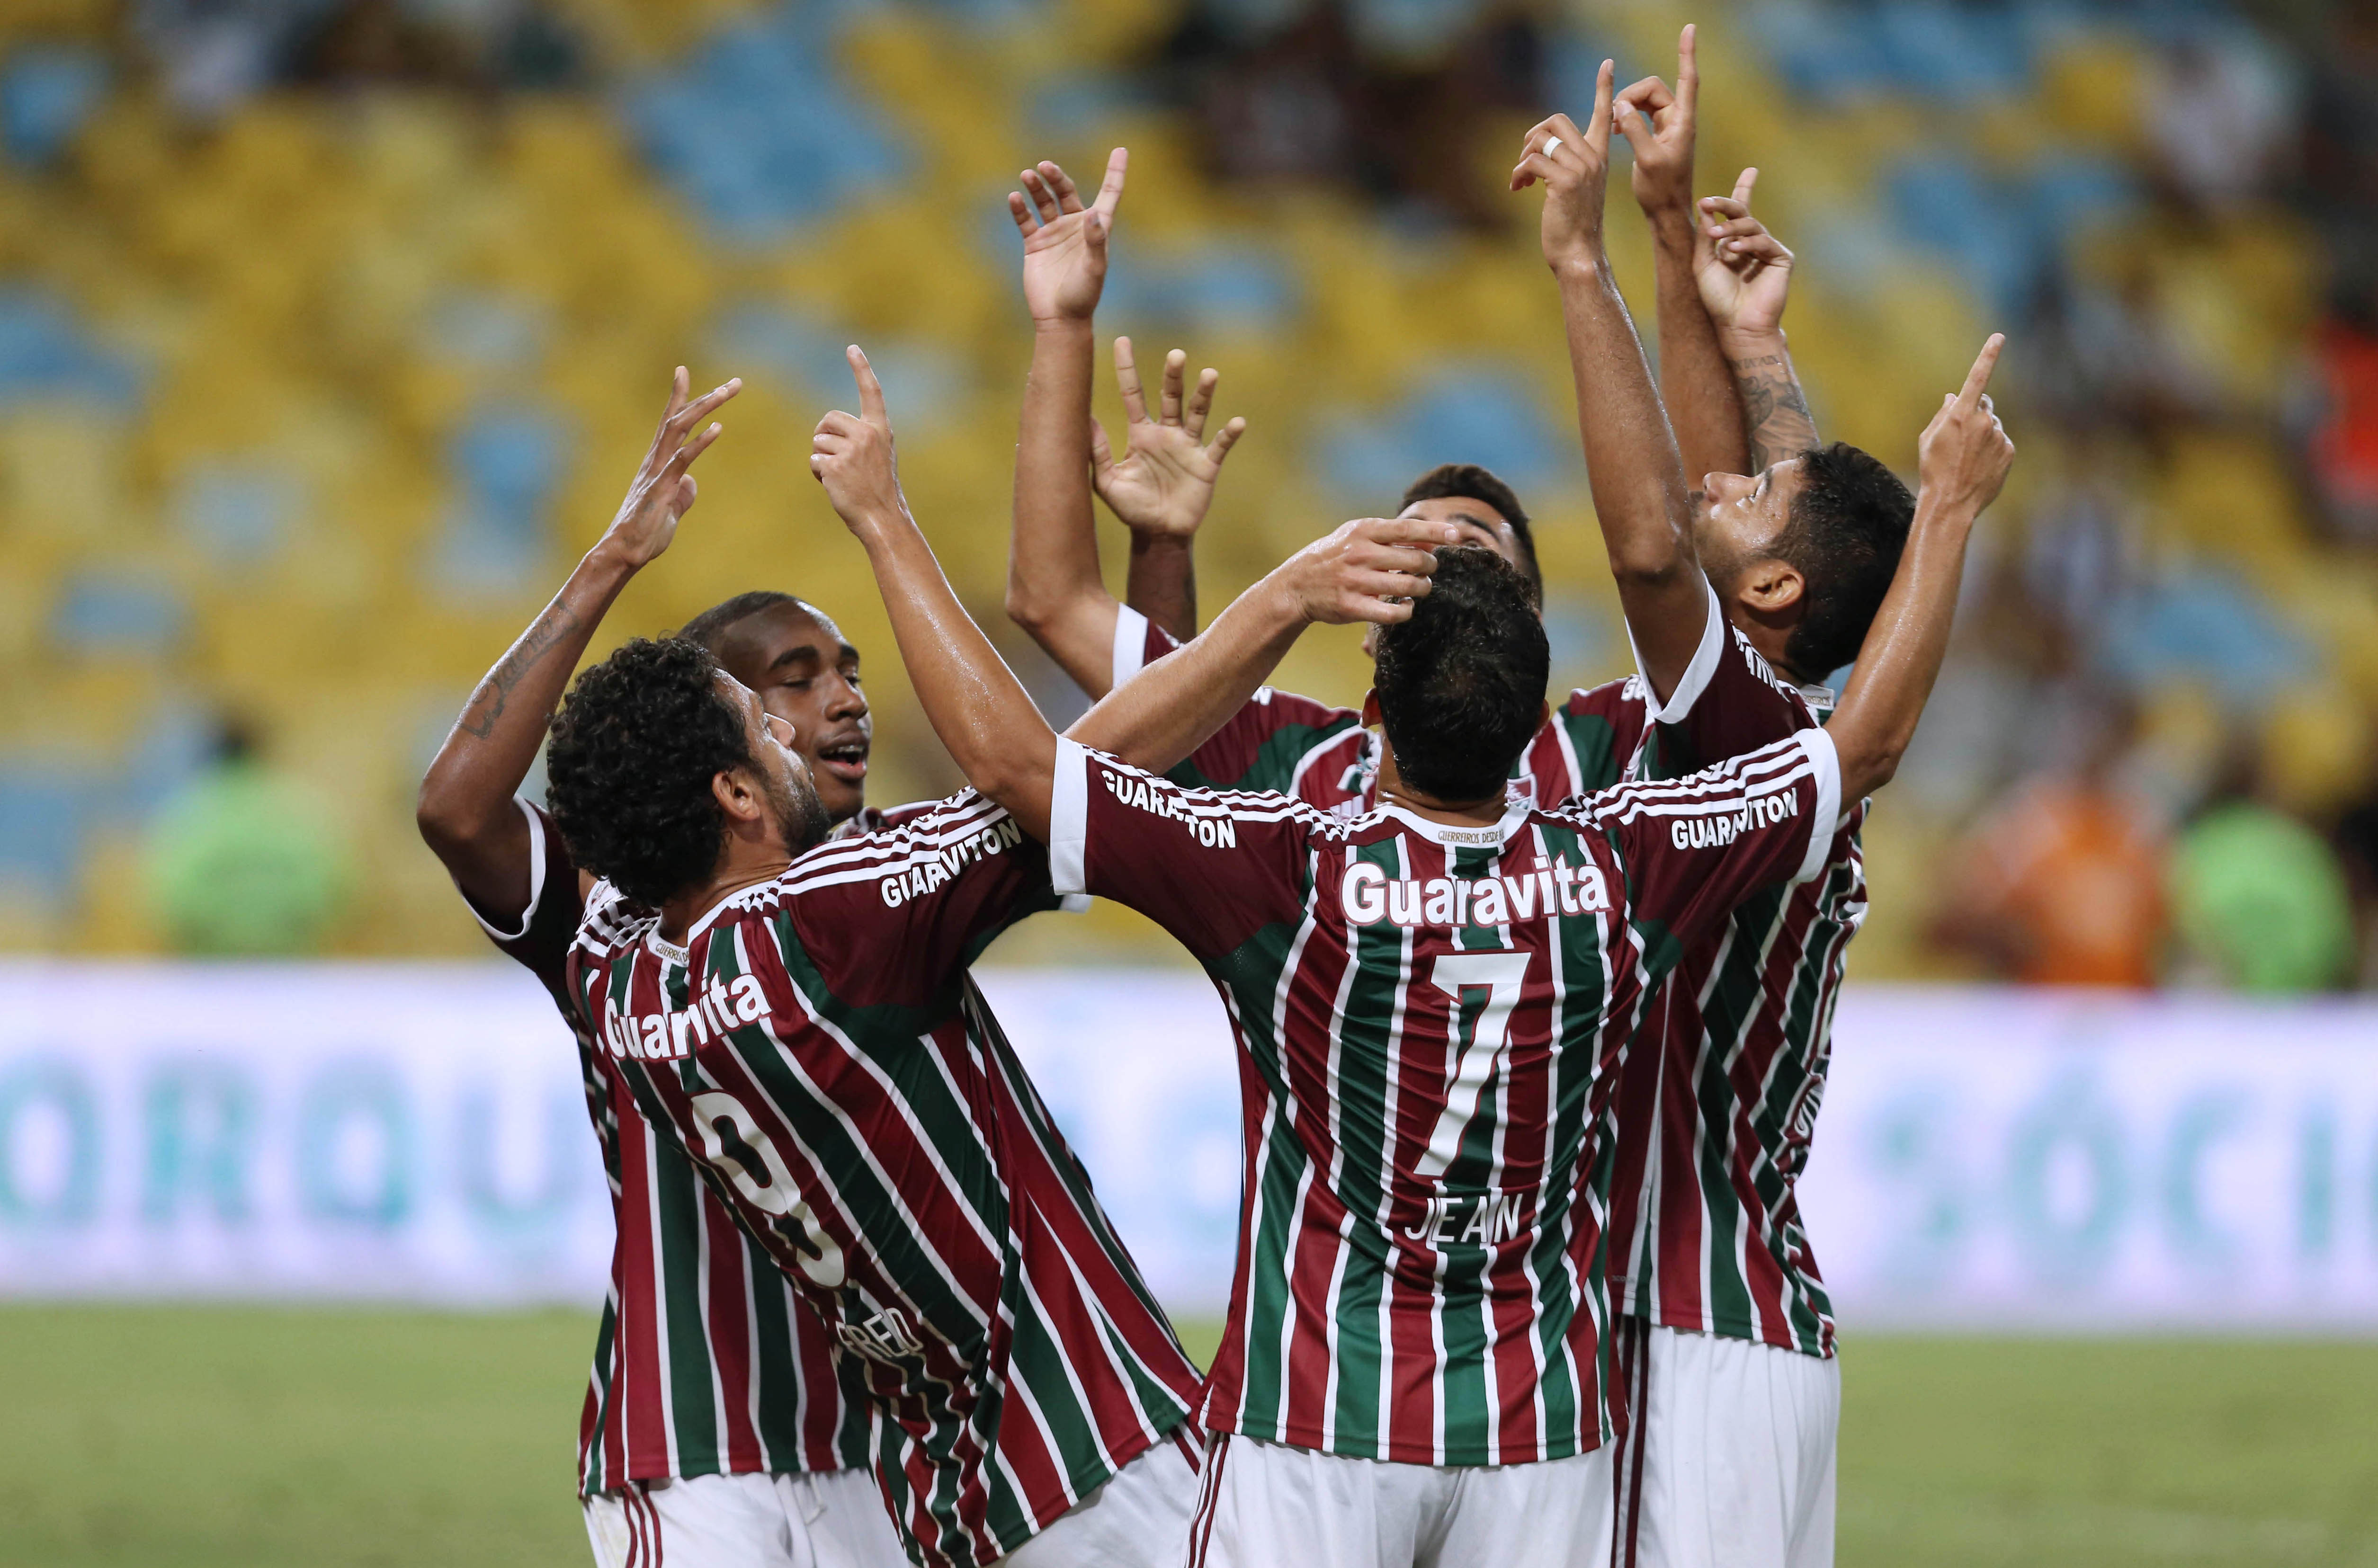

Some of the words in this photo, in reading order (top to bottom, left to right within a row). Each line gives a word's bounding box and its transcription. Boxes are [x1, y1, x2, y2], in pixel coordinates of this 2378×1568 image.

[1341, 853, 1611, 926] Guaravita
[1438, 830, 1479, 844] GUERREIROS
[1482, 831, 1499, 843] DESDE
[1413, 952, 1531, 1176] 7
[691, 1091, 845, 1287] 9
[1404, 1193, 1523, 1243] JEAN
[1859, 1034, 2378, 1274] SÓCI
